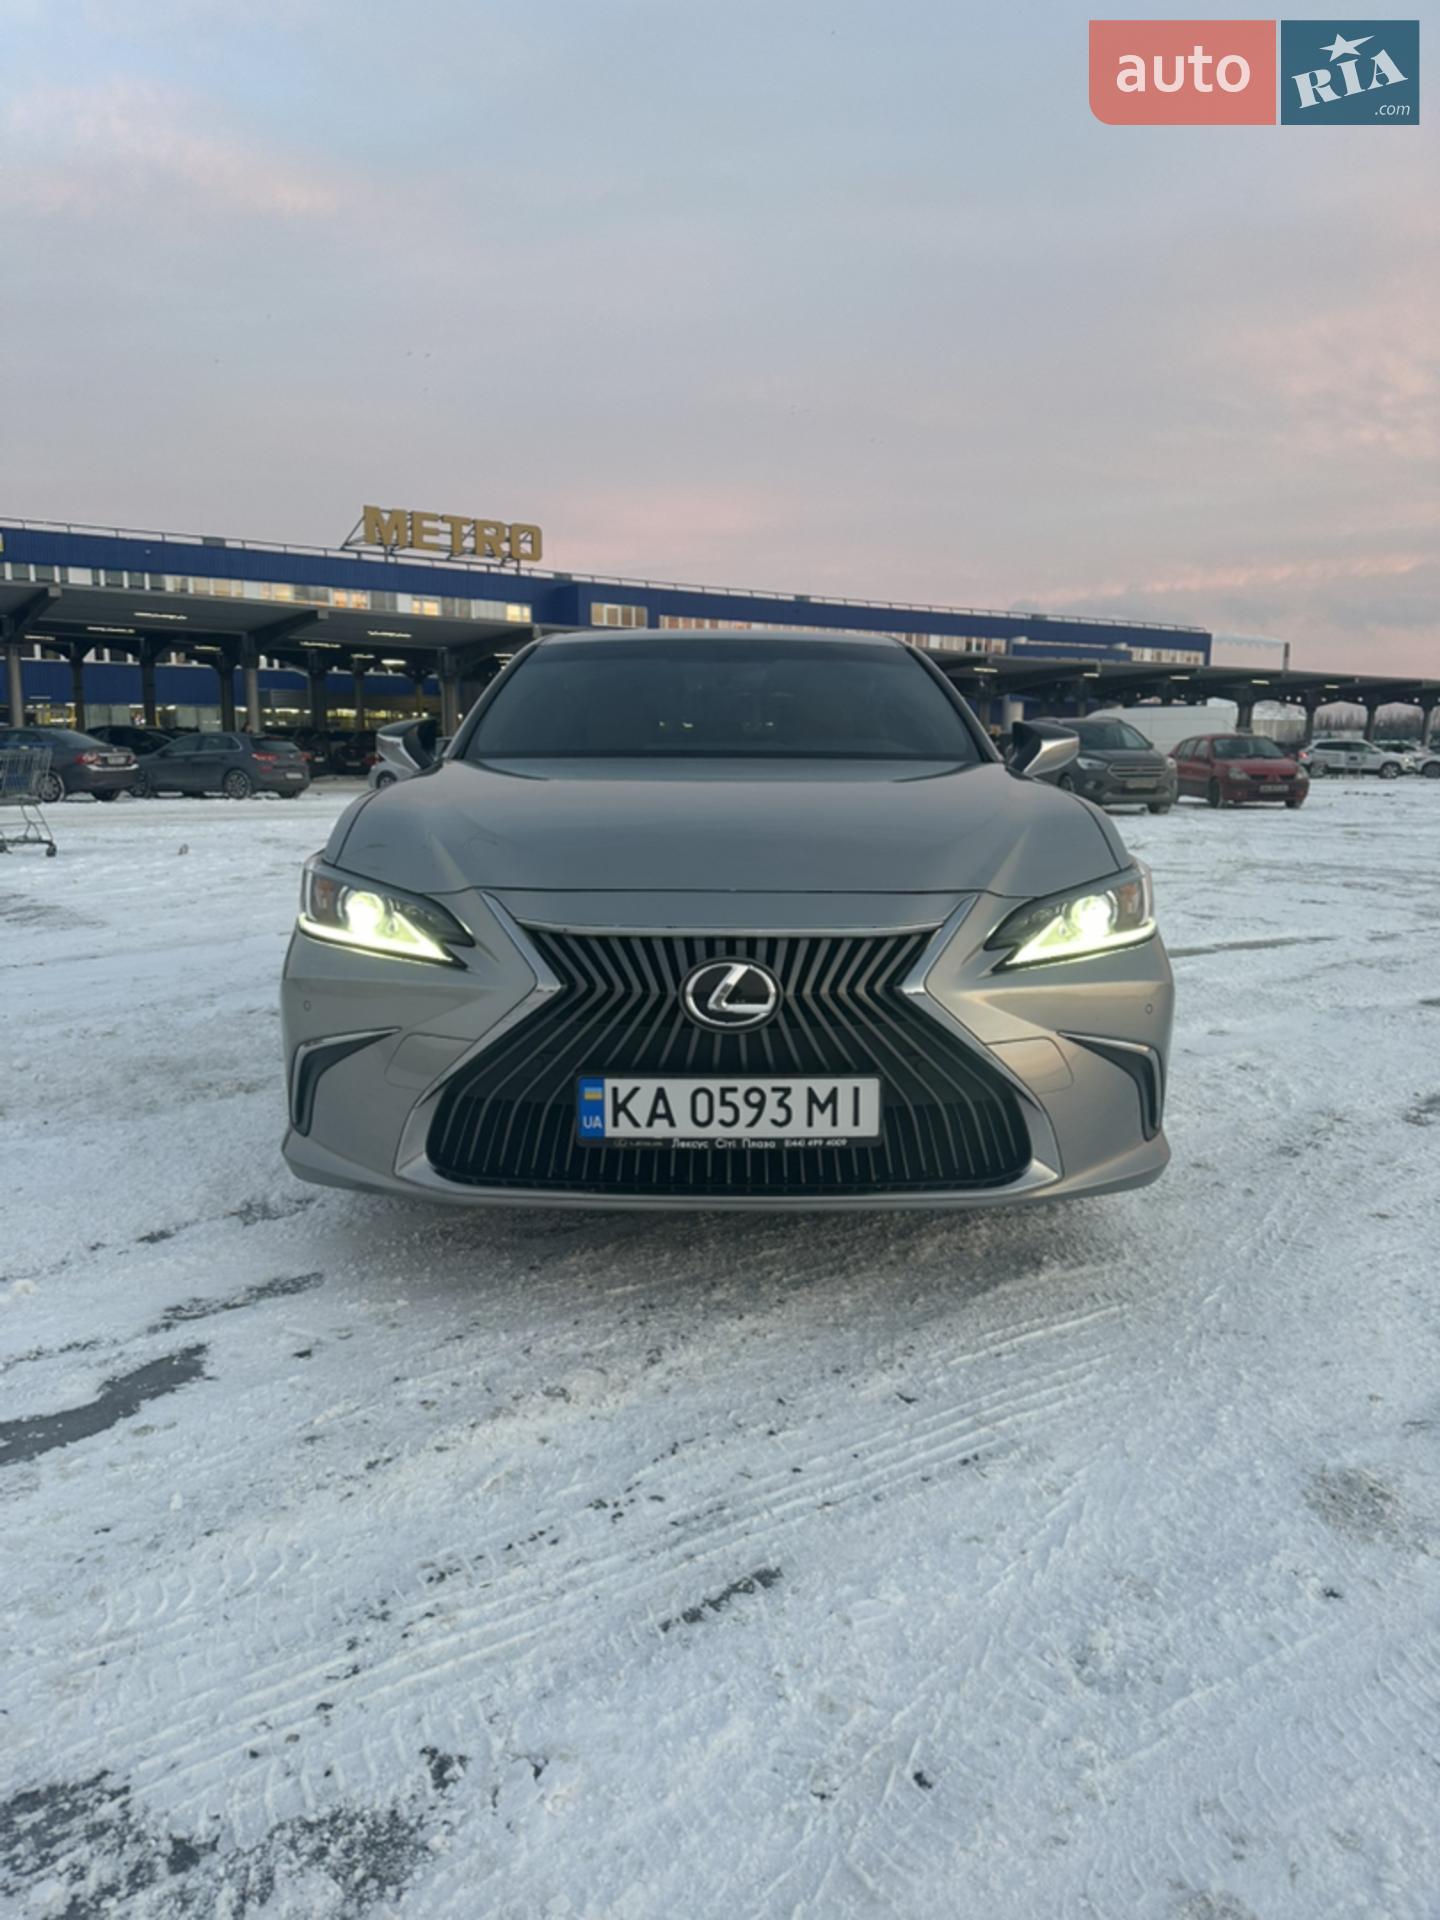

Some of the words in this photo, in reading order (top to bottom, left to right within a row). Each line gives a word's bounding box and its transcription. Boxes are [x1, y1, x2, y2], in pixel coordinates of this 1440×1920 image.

[363, 505, 543, 562] METRO
[582, 1115, 603, 1129] UA
[611, 1086, 677, 1128] KA
[690, 1086, 793, 1128] 0593
[806, 1086, 860, 1127] MI
